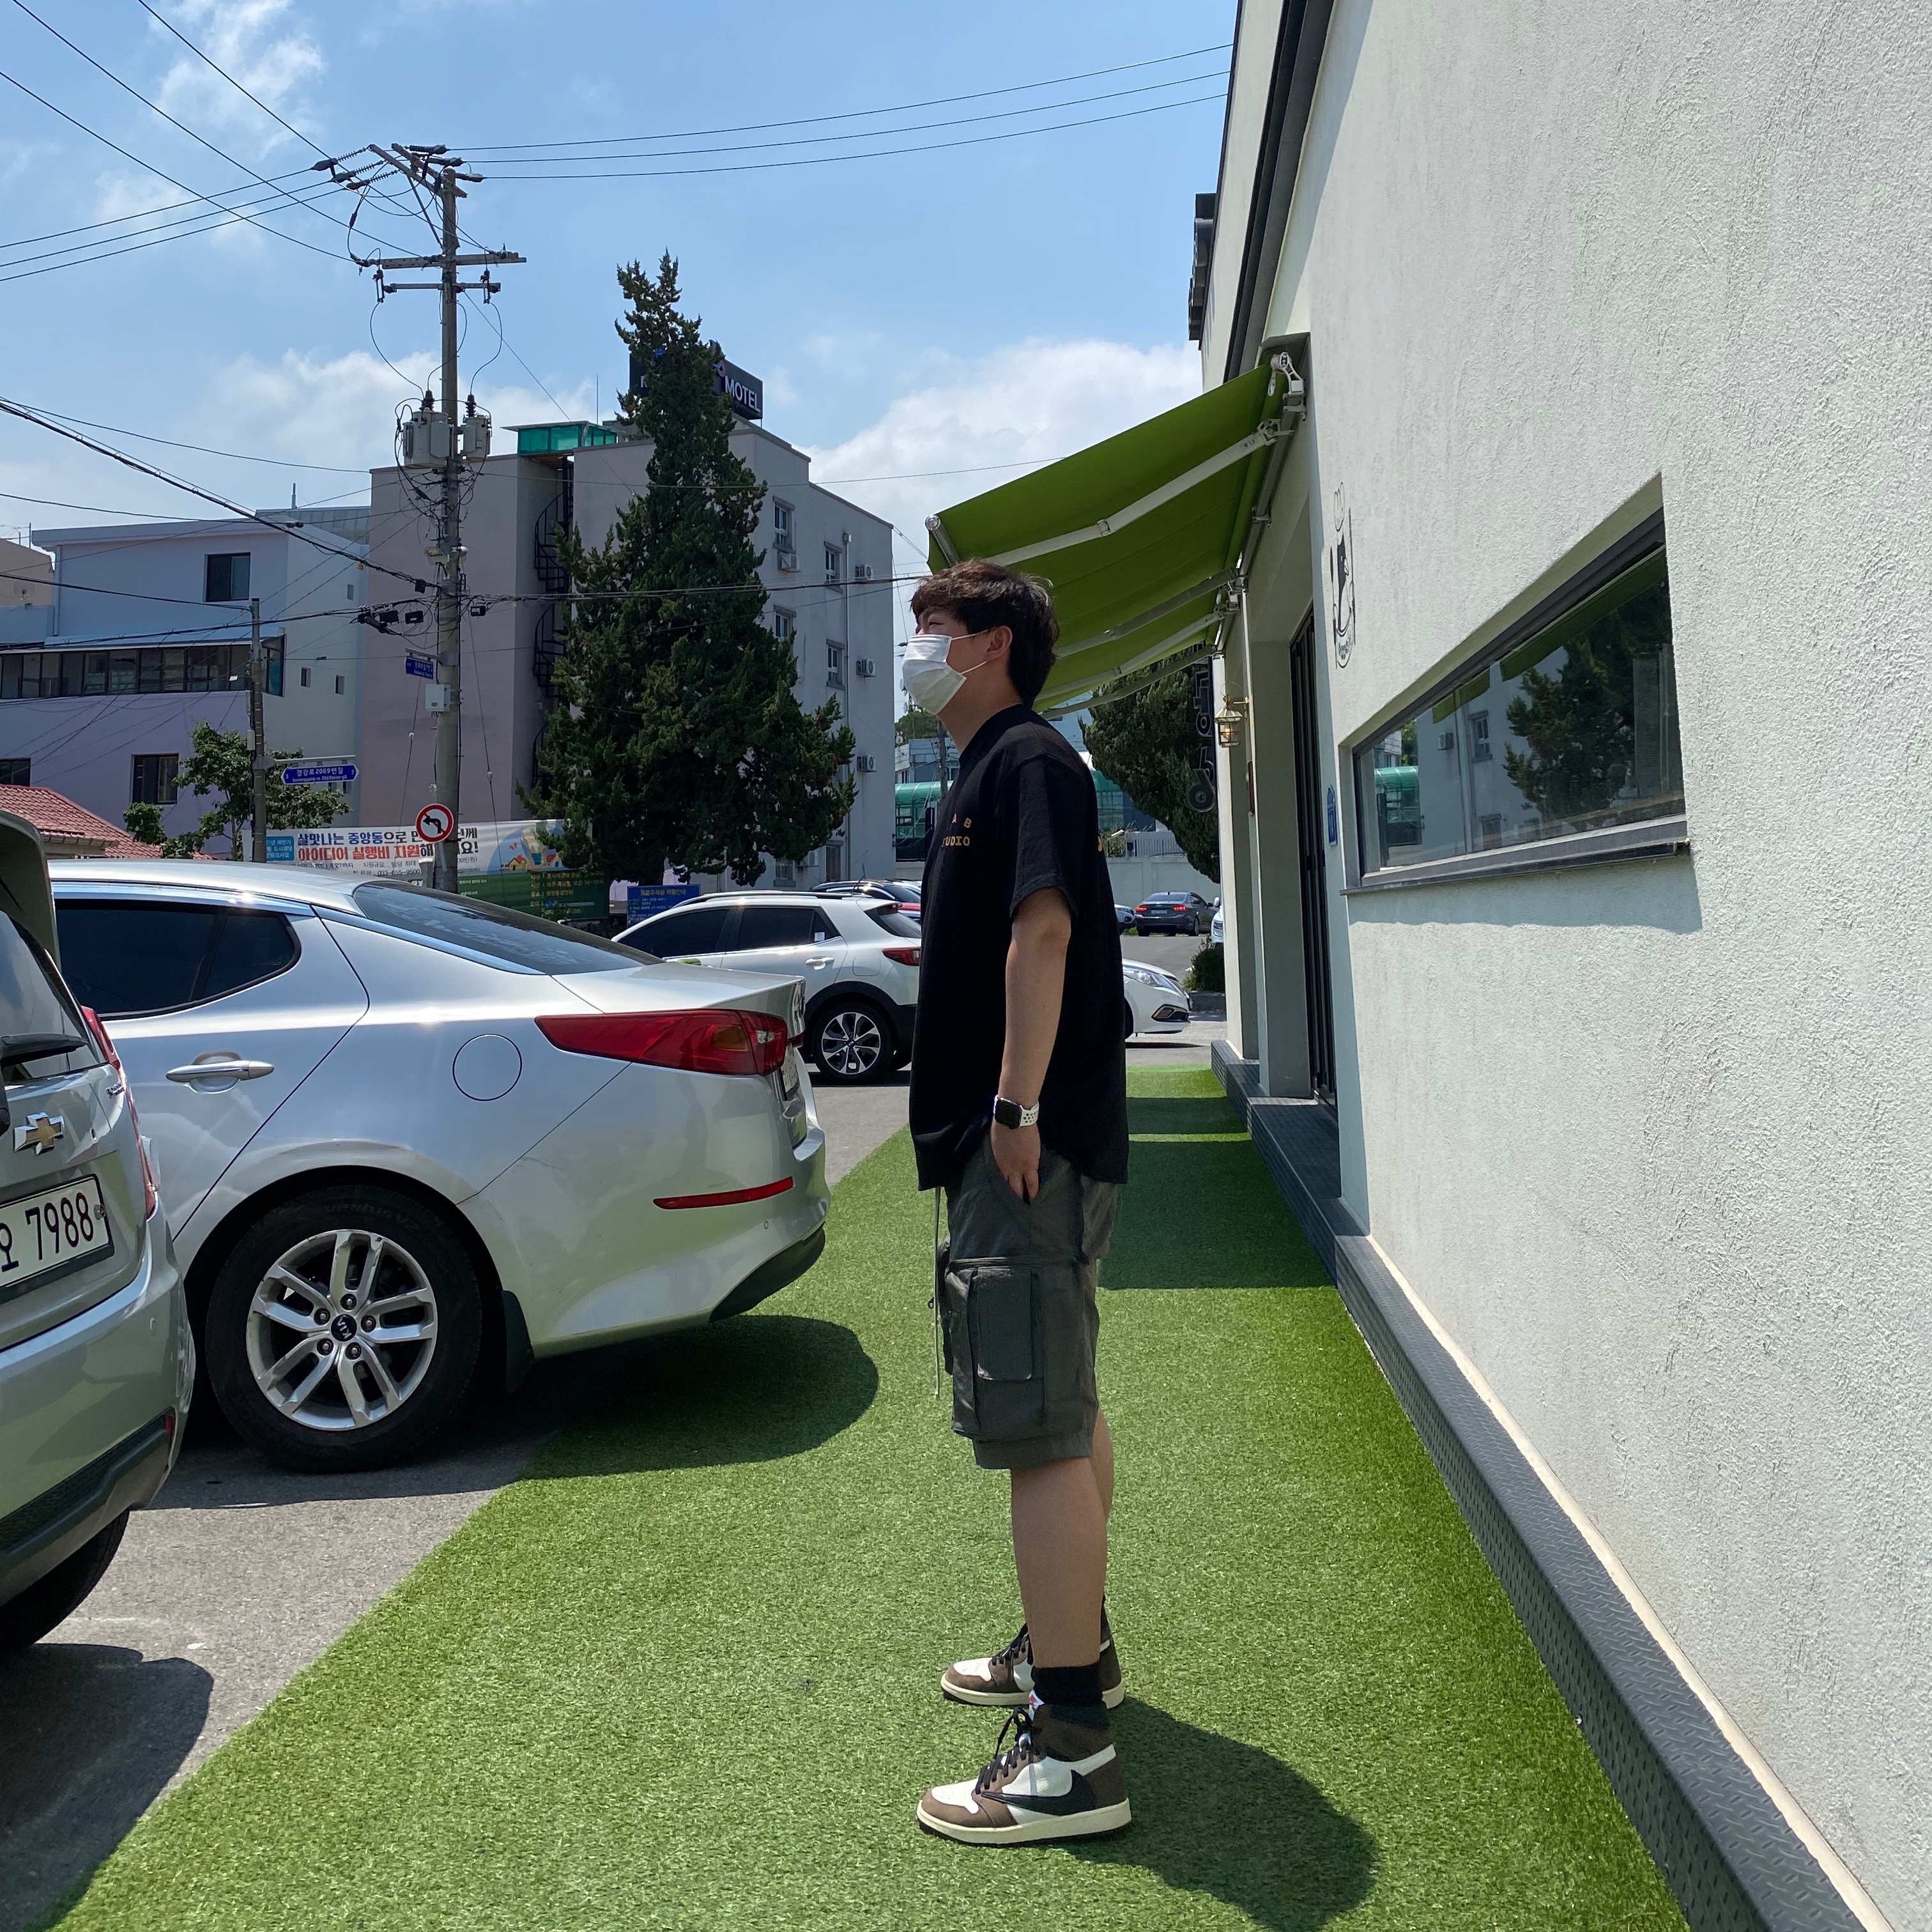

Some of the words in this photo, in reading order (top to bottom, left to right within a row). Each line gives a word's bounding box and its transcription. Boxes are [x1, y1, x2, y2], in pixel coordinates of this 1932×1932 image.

[724, 375, 761, 413] MOTEL
[298, 832, 344, 846] 살맛나는
[348, 831, 408, 845] 중앙동으로
[298, 847, 349, 861] 아이디어
[353, 845, 390, 859] 실행비
[24, 1192, 94, 1261] 7988
[337, 1315, 352, 1339] KIA
